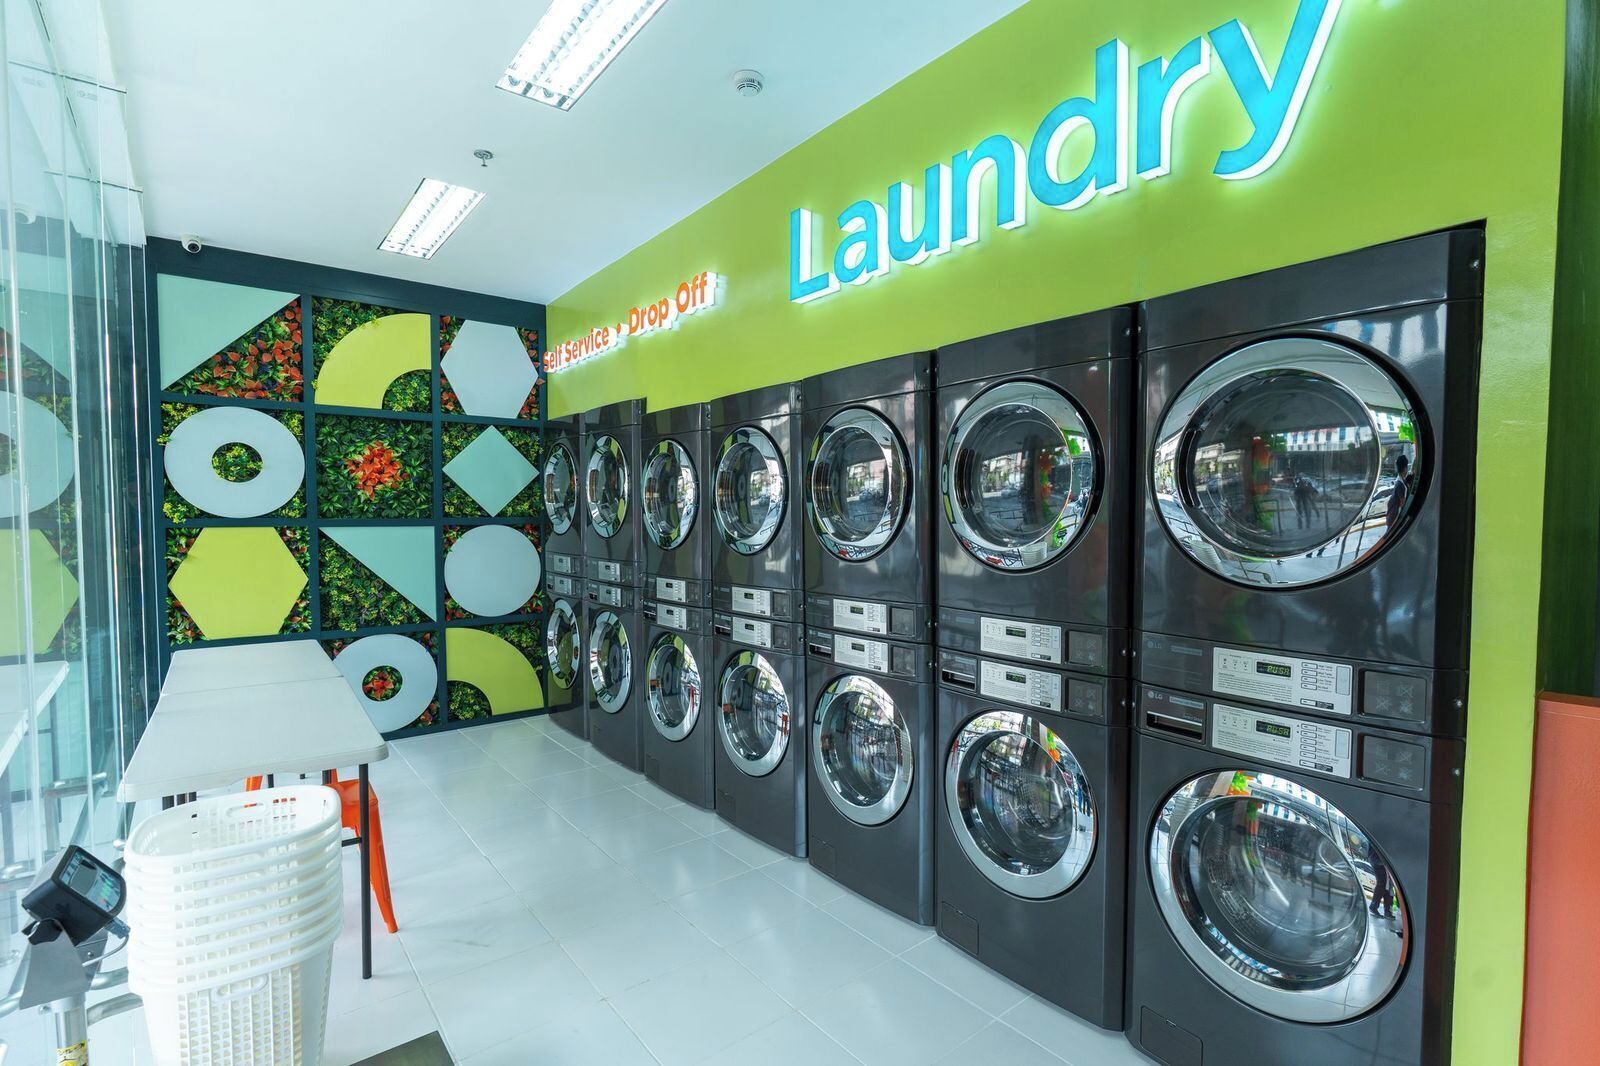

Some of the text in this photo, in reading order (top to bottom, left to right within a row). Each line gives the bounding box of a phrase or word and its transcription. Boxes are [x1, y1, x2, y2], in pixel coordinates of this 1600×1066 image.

[789, 0, 1342, 304] Laundry
[543, 271, 708, 373] Self Service Drop Off
